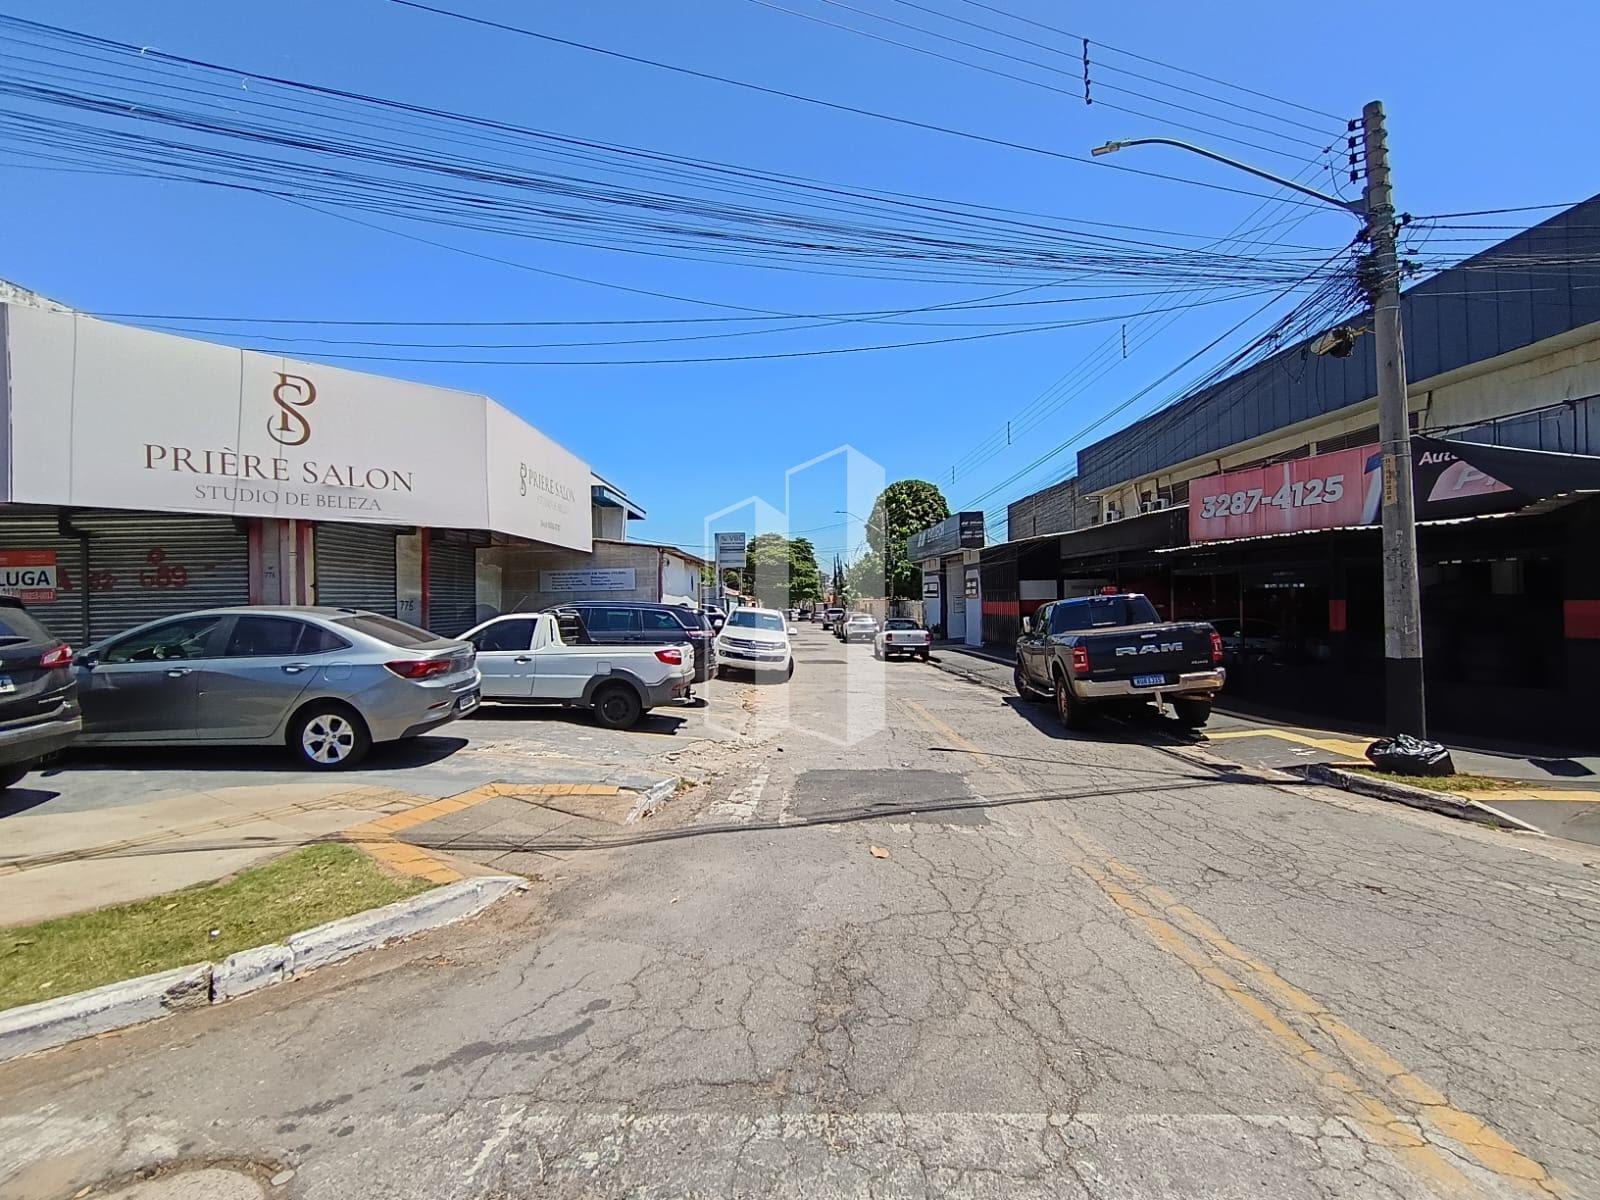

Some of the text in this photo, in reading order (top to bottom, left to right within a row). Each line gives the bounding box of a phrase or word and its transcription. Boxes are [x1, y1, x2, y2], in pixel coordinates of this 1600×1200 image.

[143, 443, 414, 492] PRIÈRE SALON
[194, 484, 382, 511] STUDIO DE BELEZA
[1200, 474, 1345, 520] 3287-4125
[1115, 642, 1184, 656] RAM
